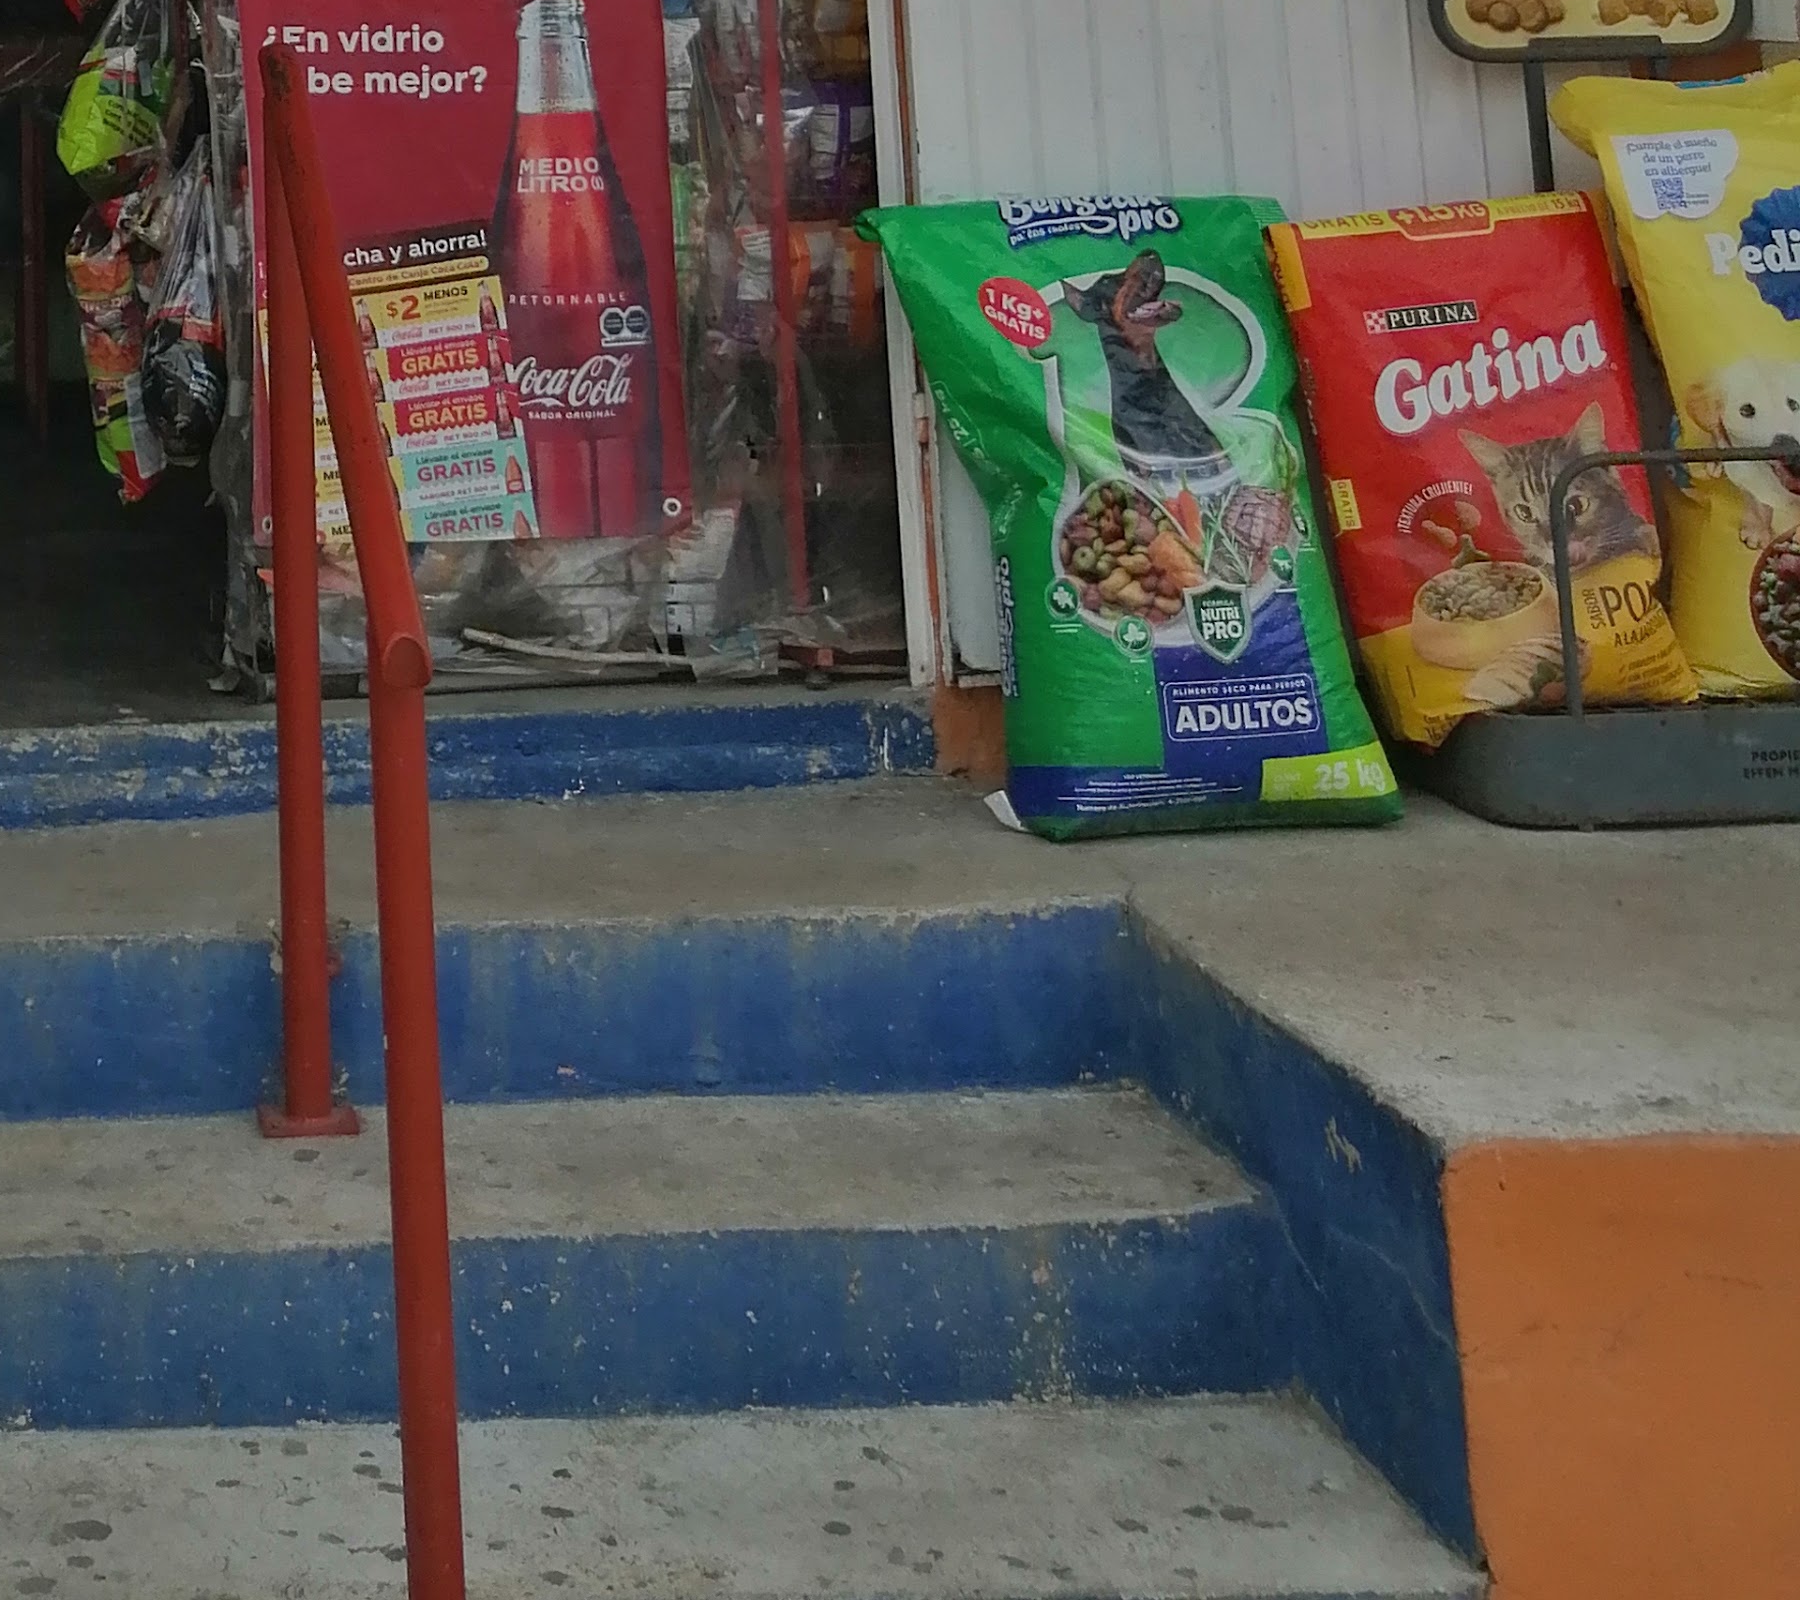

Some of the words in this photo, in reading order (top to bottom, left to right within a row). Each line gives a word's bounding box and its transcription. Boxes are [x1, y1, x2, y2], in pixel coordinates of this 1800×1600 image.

[338, 23, 444, 53] vidrio
[364, 64, 488, 100] mejor?
[519, 157, 600, 175] MEDIO
[1658, 155, 1674, 163] un
[517, 176, 589, 193] LITRO
[1118, 206, 1179, 241] pro
[343, 247, 385, 266] cha
[389, 245, 403, 264] y
[408, 229, 487, 257] ahorra!
[423, 286, 468, 301] MENOS
[509, 291, 627, 306] RETORNABLE
[984, 303, 1046, 341] GRATIS
[1388, 302, 1476, 330] PURINA
[402, 348, 479, 375] GRATIS
[505, 353, 634, 407] Coca-Cola
[1375, 319, 1608, 436] Gatina
[409, 402, 488, 429] GRATIS
[417, 458, 496, 482] GRATIS
[1337, 480, 1356, 528] GRATIS
[426, 513, 504, 537] GRATIS
[1200, 606, 1240, 622] NUTRI
[1202, 621, 1244, 640] PRO
[1176, 697, 1313, 733] ADULTOS
[1314, 761, 1349, 789] 25
[1355, 757, 1386, 791] kg
